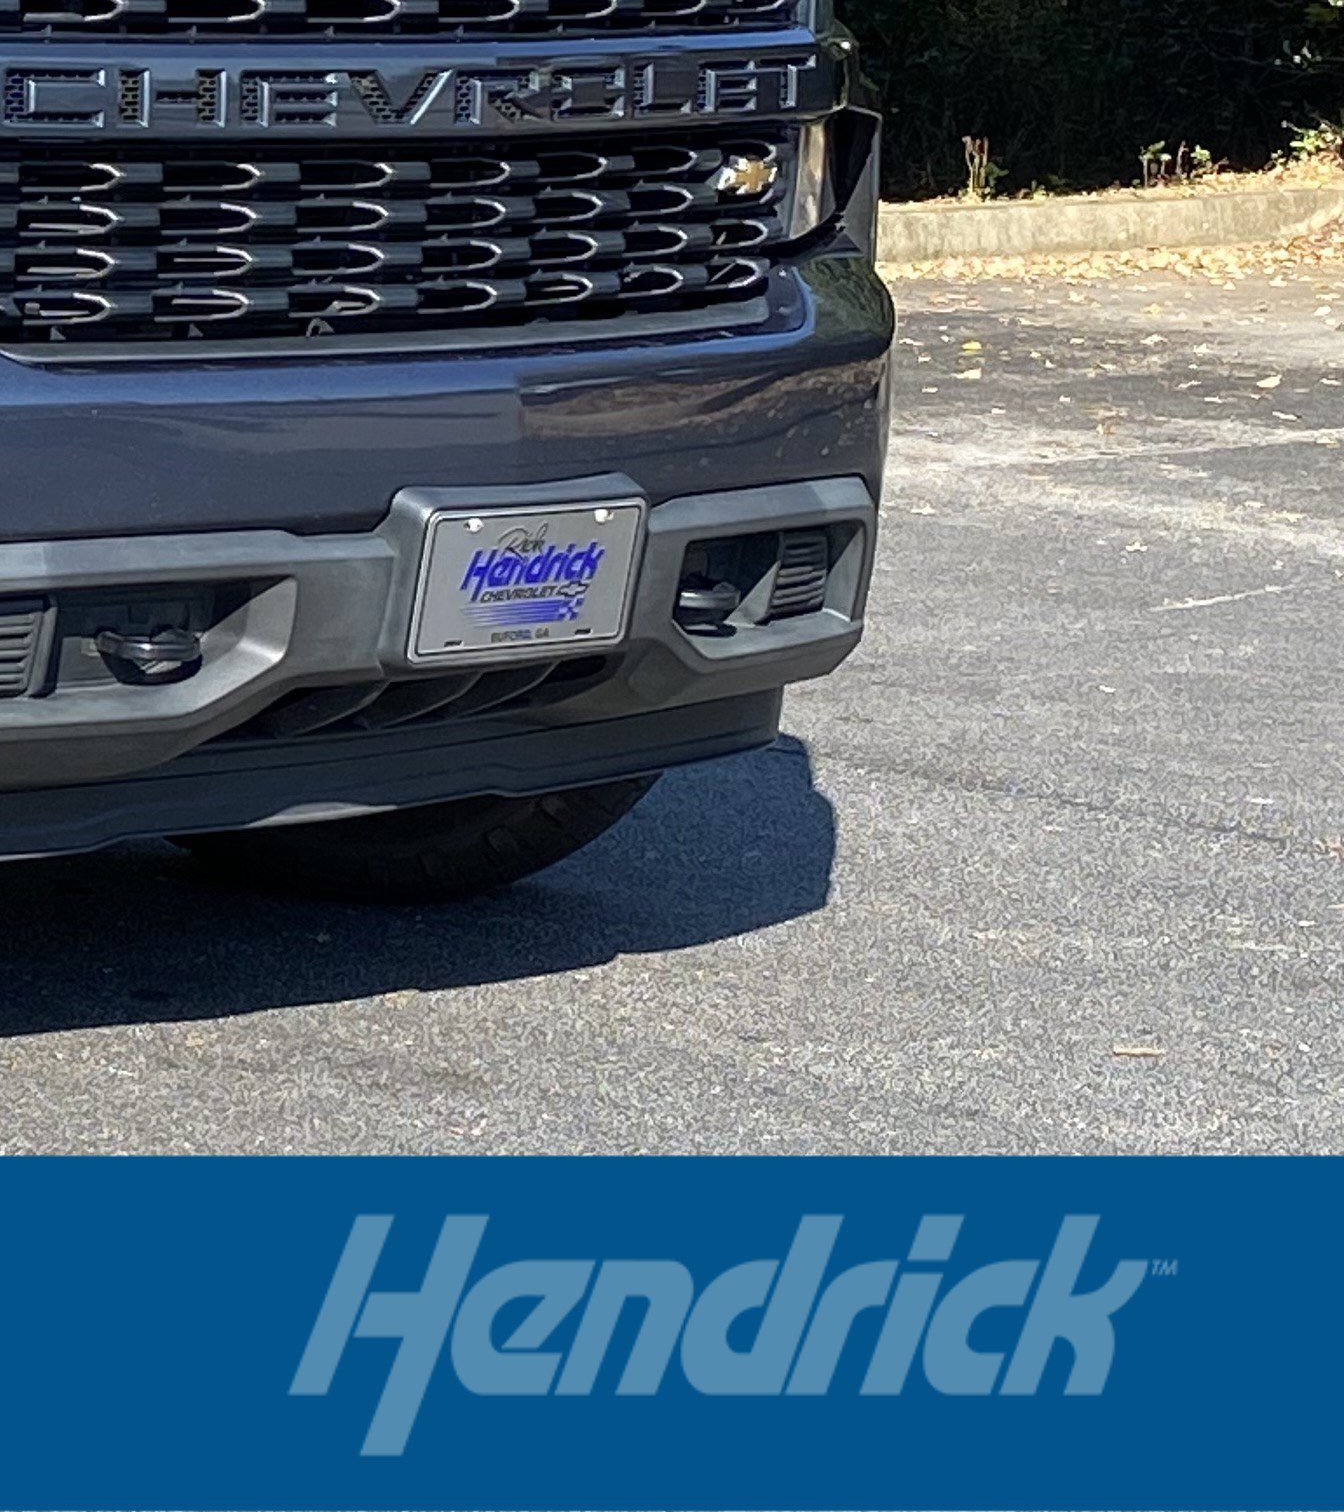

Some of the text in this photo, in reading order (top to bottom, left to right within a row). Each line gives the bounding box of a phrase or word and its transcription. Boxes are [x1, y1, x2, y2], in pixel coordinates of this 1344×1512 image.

[2, 54, 817, 128] CHEVROLET
[459, 539, 606, 603] Hendrick
[480, 584, 557, 604] CHEVROLET
